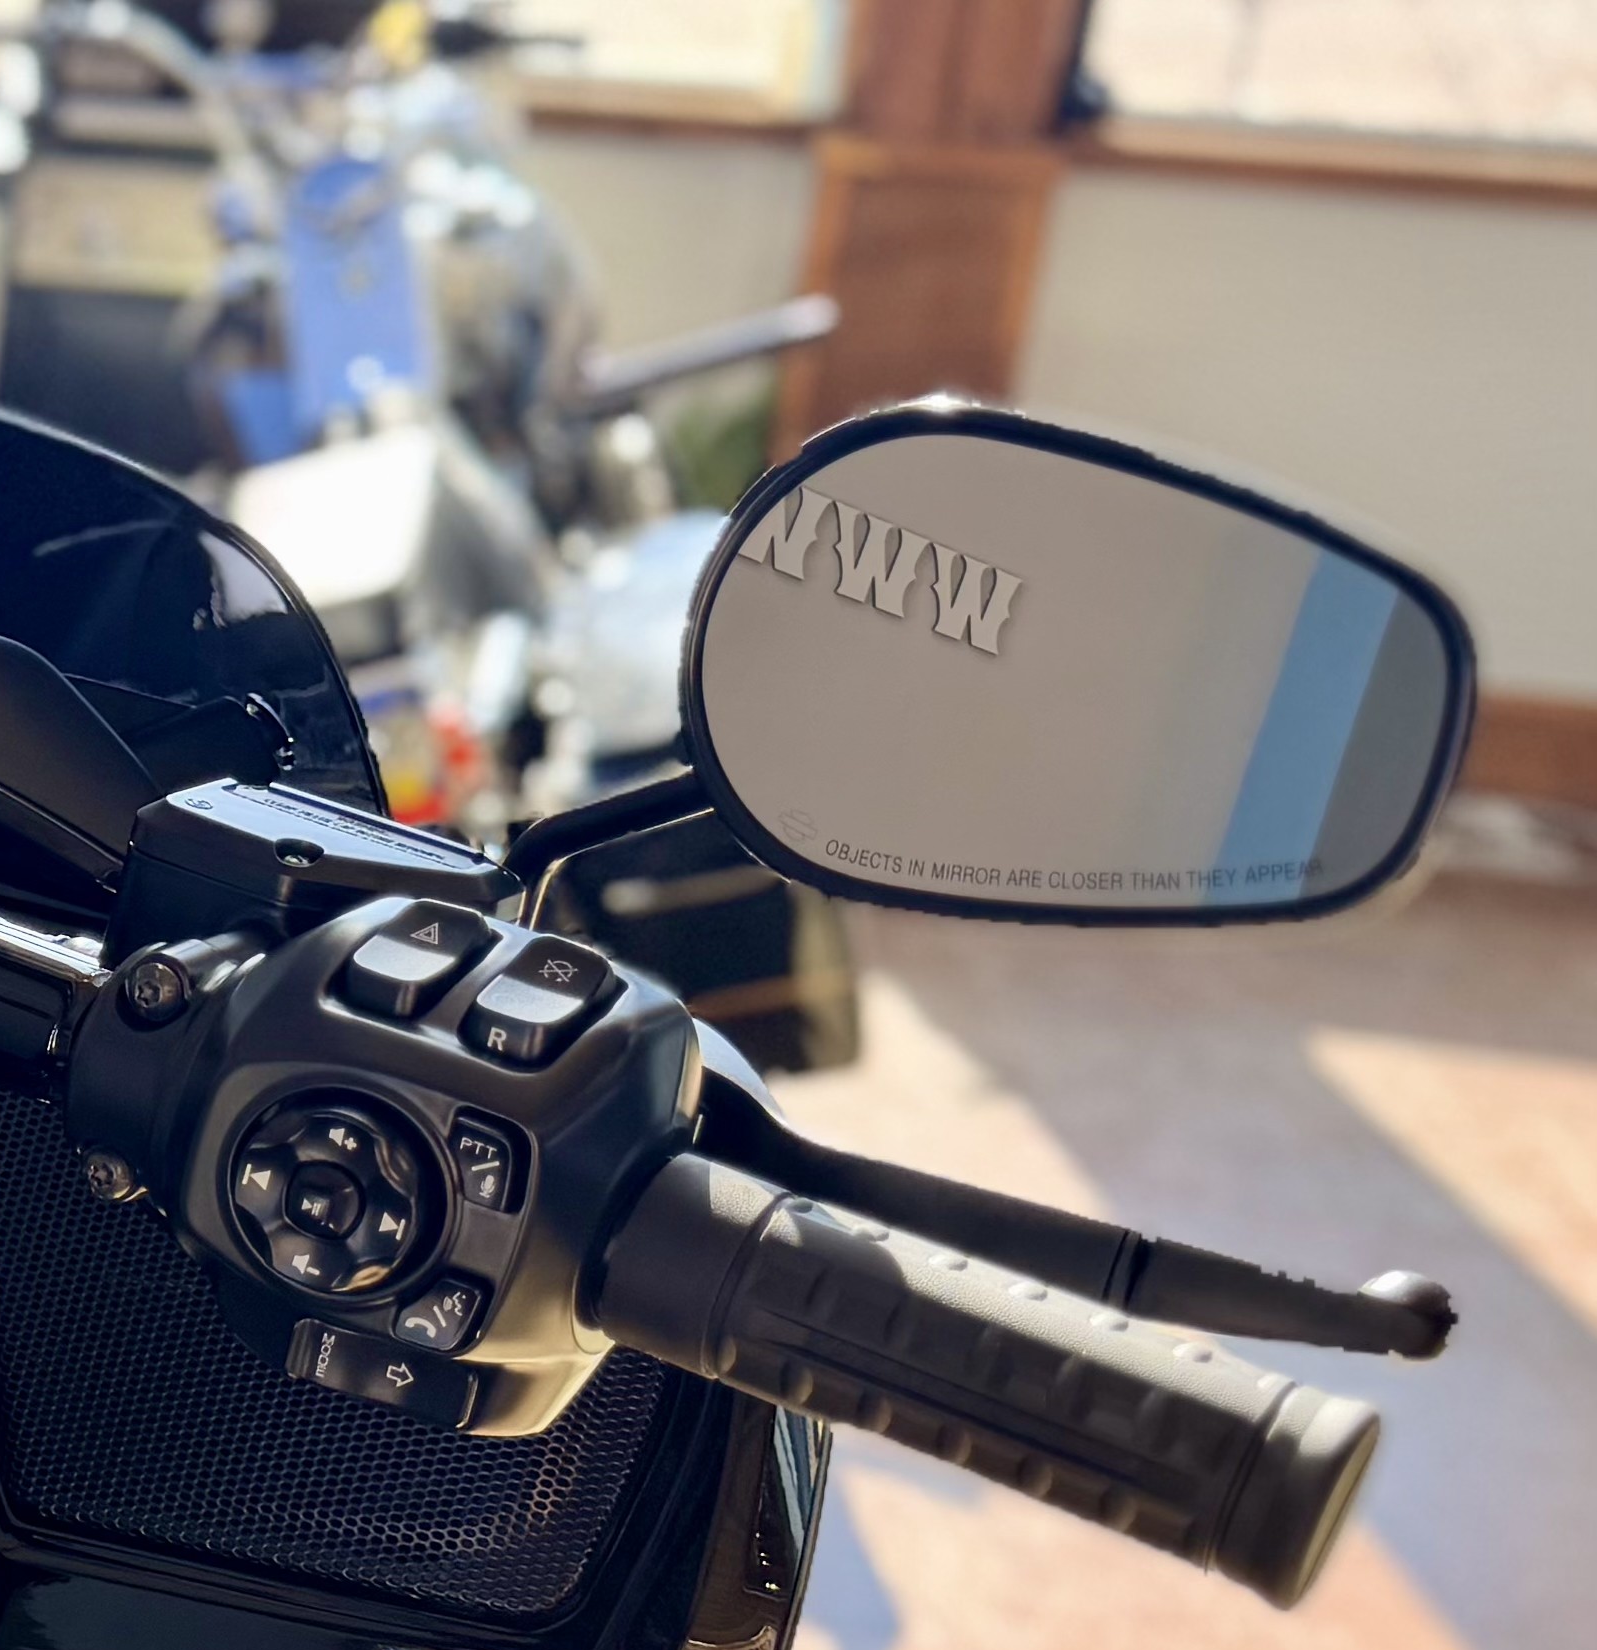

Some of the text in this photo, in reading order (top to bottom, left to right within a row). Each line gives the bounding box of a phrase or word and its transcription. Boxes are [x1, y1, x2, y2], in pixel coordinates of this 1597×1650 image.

[825, 839, 1325, 891] OBJECTS IN MIRROR ARE CLOSER THAN THEY APPEAR
[487, 1026, 507, 1052] R
[459, 1136, 497, 1159] PTT
[315, 1332, 336, 1378] MODE
